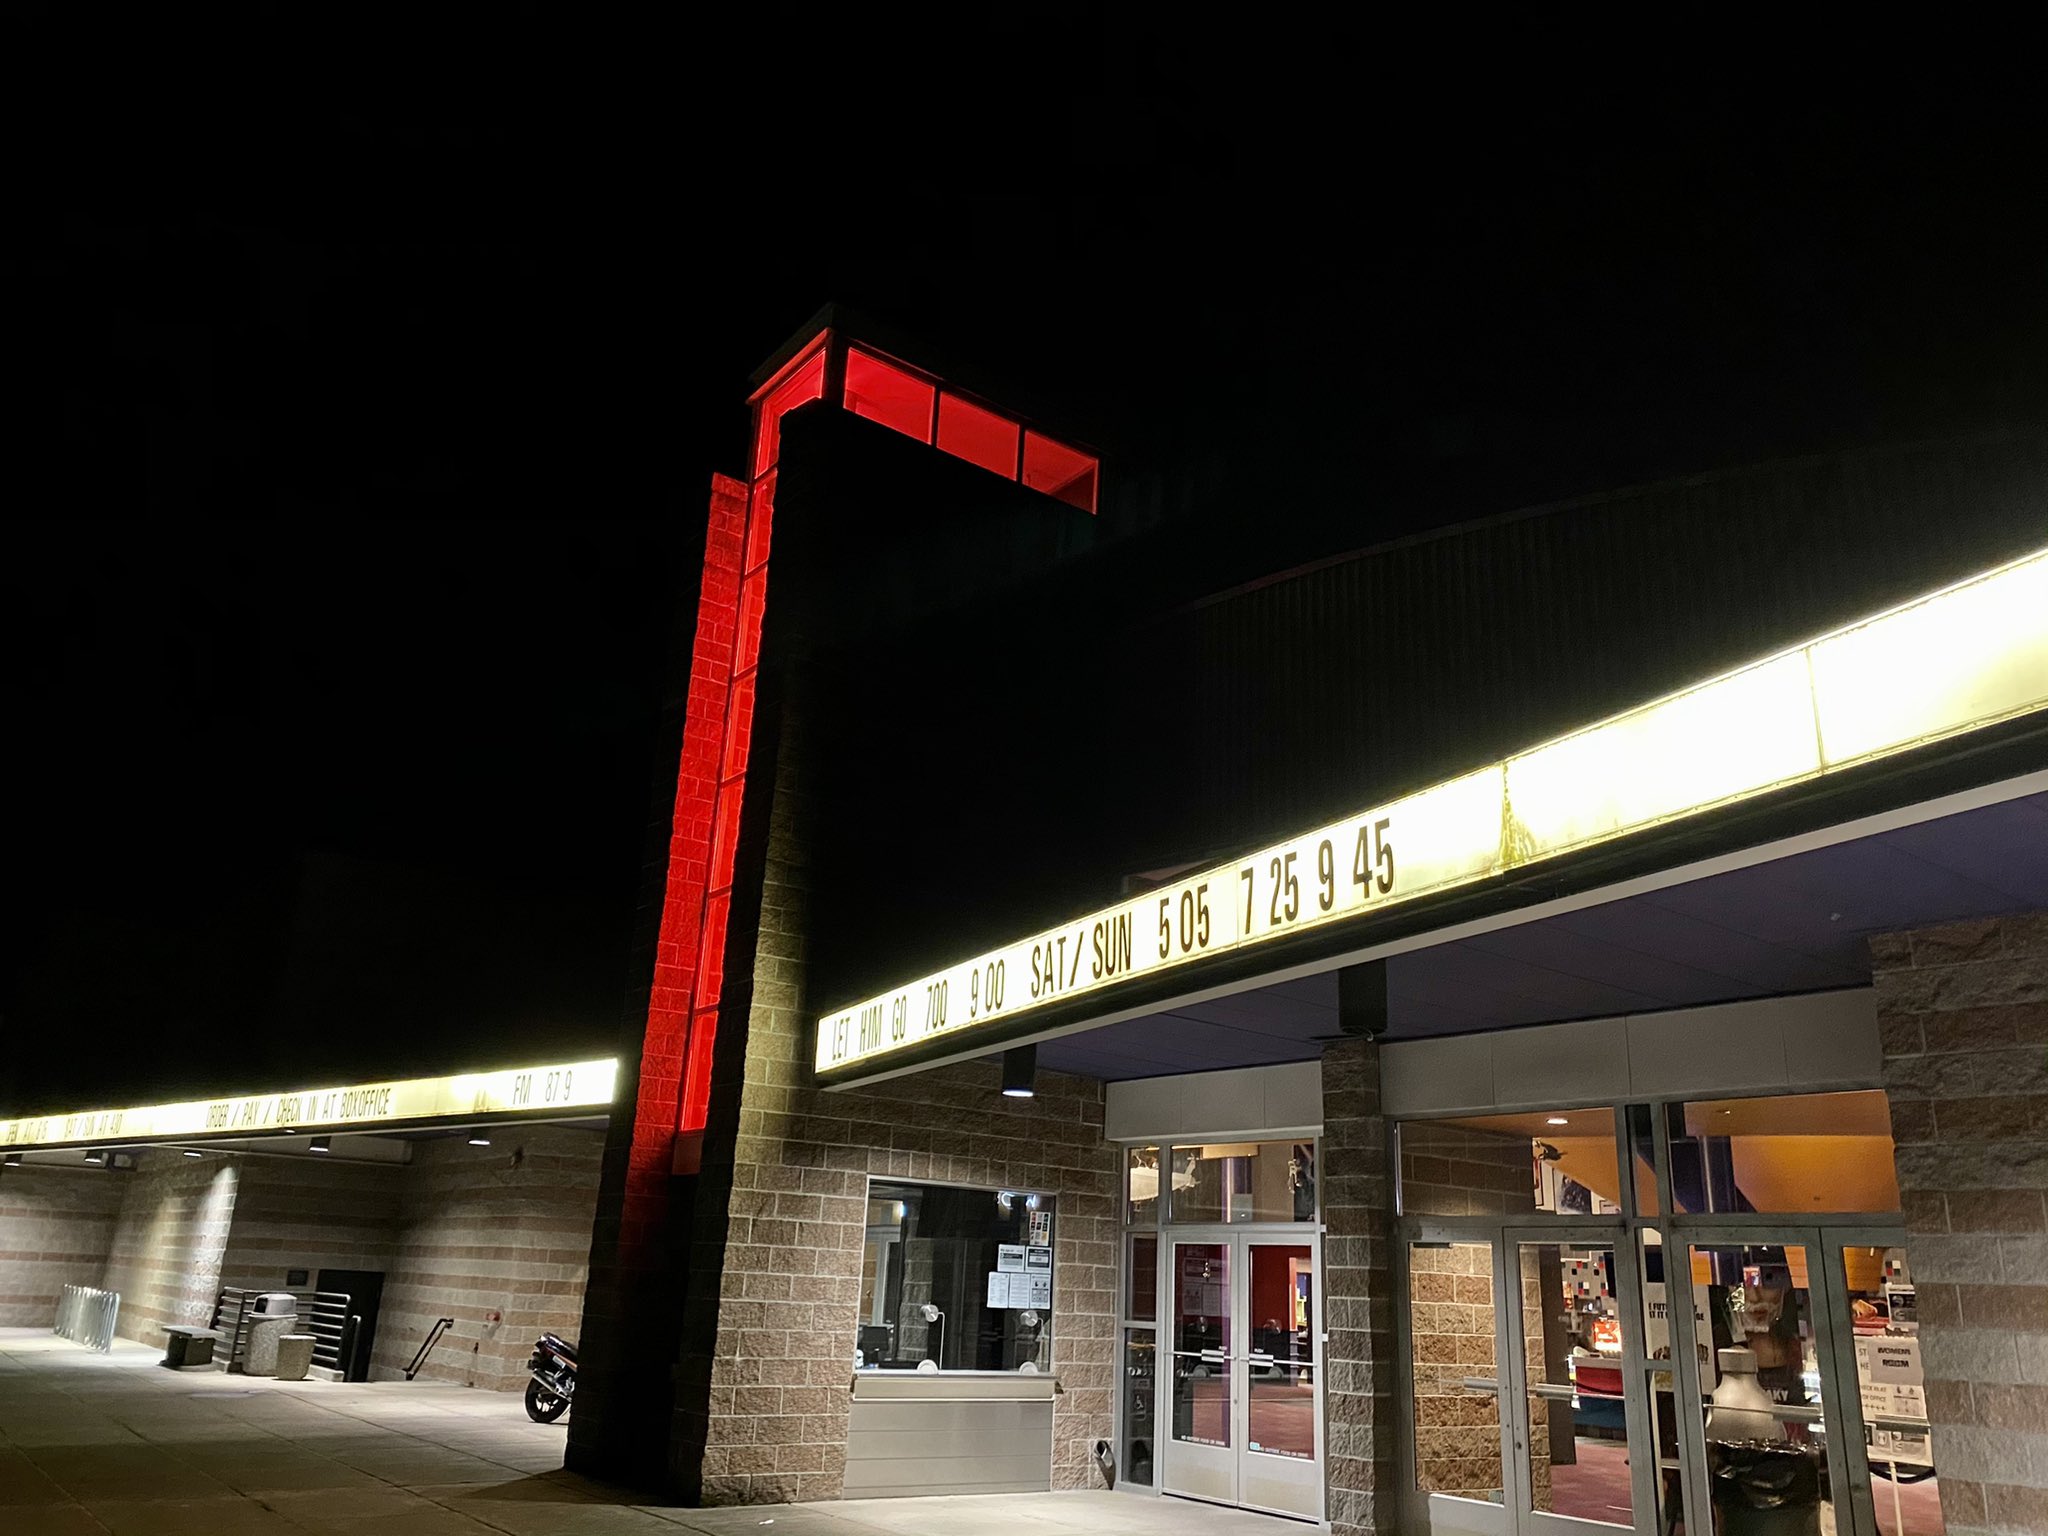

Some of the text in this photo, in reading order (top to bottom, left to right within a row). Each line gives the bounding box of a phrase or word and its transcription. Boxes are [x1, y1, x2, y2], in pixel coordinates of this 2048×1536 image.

[832, 1017, 851, 1060] LET
[859, 1003, 883, 1053] HIM
[892, 995, 907, 1041] GO
[513, 1074, 532, 1105] FM
[206, 1103, 230, 1129] ORDER
[242, 1100, 261, 1126] PAY
[276, 1096, 301, 1123] CHECK
[307, 1095, 318, 1121] IN
[322, 1093, 337, 1119] AT
[1882, 1359, 1910, 1368] ROOM
